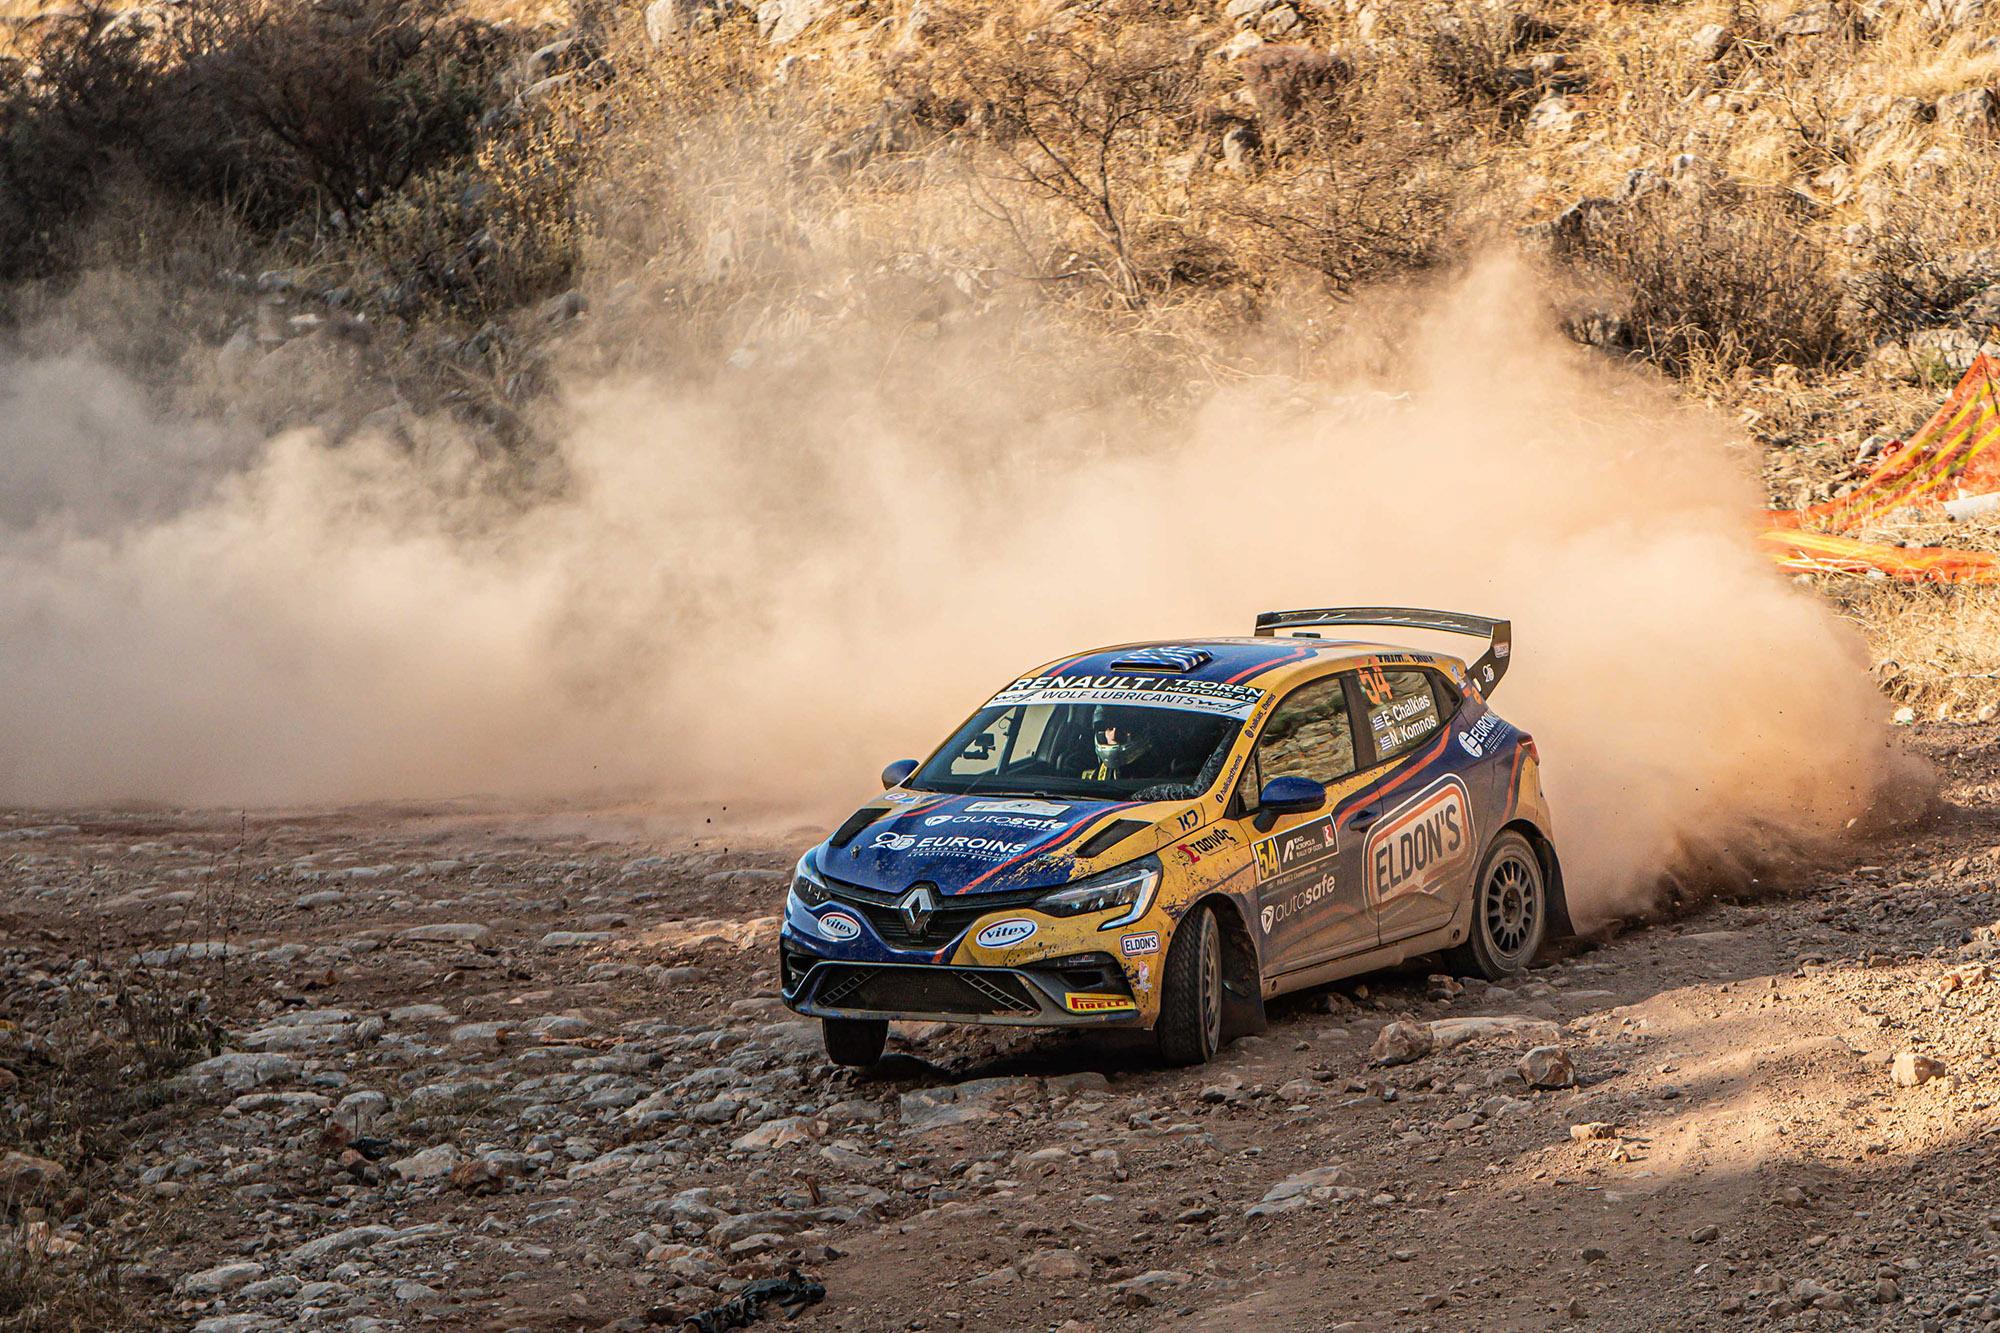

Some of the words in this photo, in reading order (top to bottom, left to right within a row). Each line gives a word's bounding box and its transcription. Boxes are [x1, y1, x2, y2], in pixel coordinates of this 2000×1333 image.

[1003, 675, 1155, 691] RENAULT
[1172, 678, 1266, 698] TEOREN
[1353, 655, 1393, 705] 54
[1041, 690, 1088, 699] WOLF
[1091, 690, 1195, 705] LUBRICANTS
[1165, 685, 1234, 698] MOTORS
[1381, 710, 1395, 727] E.
[1392, 695, 1431, 721] Chalkias
[1389, 730, 1402, 747] N.
[1400, 715, 1437, 742] Komnos
[952, 815, 1068, 831] autosafe
[916, 836, 1028, 854] EUROINS
[1375, 803, 1461, 896] ELDON'S
[1255, 839, 1279, 879] 54
[1275, 873, 1336, 922] autosafe
[826, 917, 853, 935] vitex
[986, 925, 1028, 939] vitex
[1125, 936, 1157, 951] ELDON'S
[1071, 997, 1129, 1009] PIRELLI
